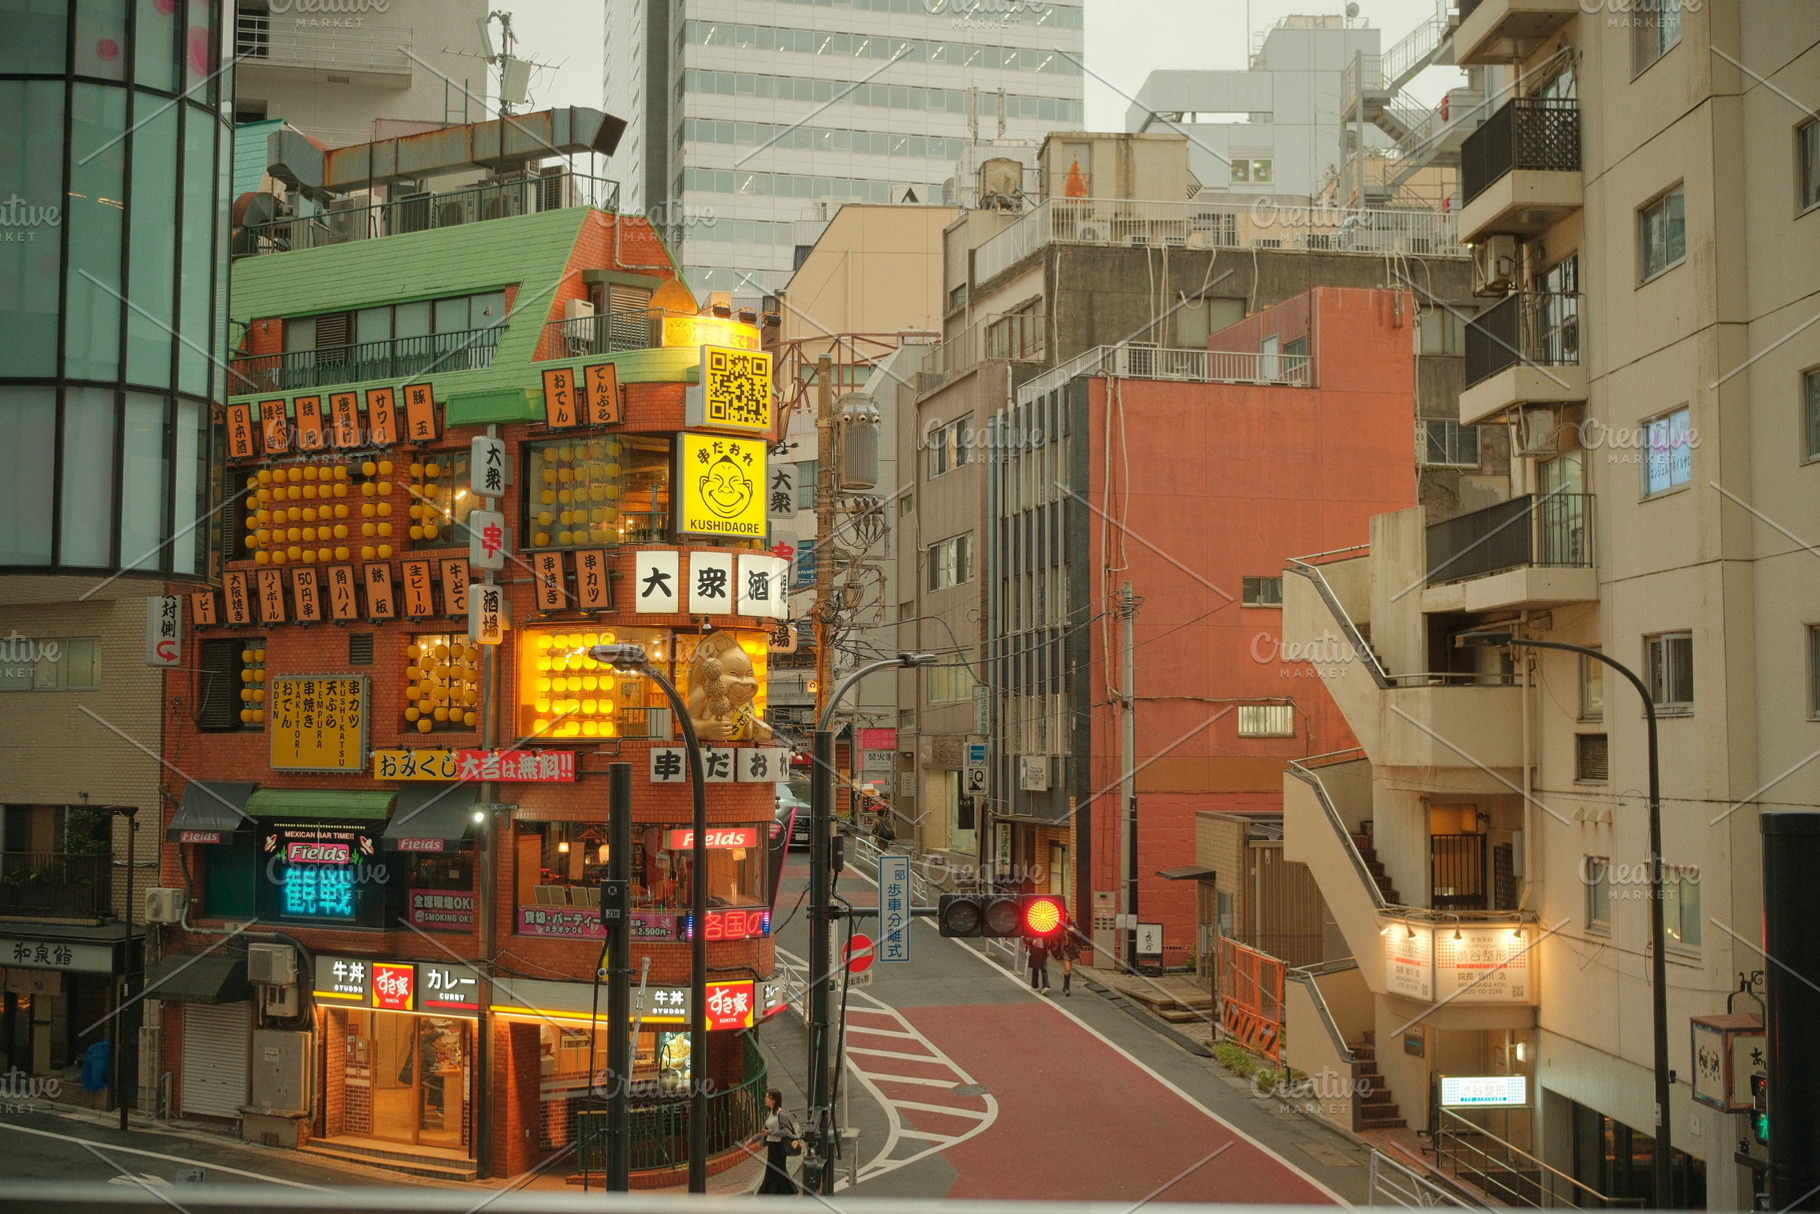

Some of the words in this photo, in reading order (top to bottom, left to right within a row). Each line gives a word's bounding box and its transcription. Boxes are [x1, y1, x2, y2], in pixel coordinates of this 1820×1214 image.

[338, 397, 354, 443] 唐揚げ
[376, 393, 388, 441] サワー
[413, 389, 428, 436] 豚玉
[554, 374, 568, 423] おでん
[234, 408, 248, 454] 日本酒
[697, 442, 753, 466] 串だおれ
[485, 443, 502, 491] 大衆
[770, 469, 792, 514] 大衆
[482, 522, 502, 559] 串
[690, 519, 760, 534] KUSHIDAORE
[230, 574, 244, 622] 大阪焼き
[264, 572, 279, 620] ハイボール
[298, 572, 314, 618] 50円串
[336, 569, 349, 616] 角ハイ
[372, 567, 388, 614] 鉄板
[410, 565, 426, 614] 生ビール
[450, 563, 465, 610] 牛どて
[543, 556, 558, 604] 串焼き
[584, 554, 600, 603] 串カツ
[482, 590, 499, 638] 酒場
[282, 682, 293, 728] おでん
[304, 680, 314, 728] 串焼き
[338, 681, 346, 766] KUSHIKATSU
[348, 680, 360, 728] 串カツ
[380, 754, 457, 778] おみくじ
[654, 750, 788, 781] 串だおれ
[182, 831, 218, 840] Fields
[284, 830, 316, 838] MEXICAN
[333, 832, 354, 840] TIME!!
[290, 845, 347, 861] Fields
[400, 839, 441, 850] Fields
[682, 832, 745, 846] Felds
[894, 863, 906, 880] 一部
[424, 912, 457, 922] SMOKING
[888, 883, 902, 958] 歩車分離式
[333, 961, 365, 983] 牛丼
[376, 968, 408, 998] すき家
[427, 969, 476, 990] カレー
[440, 992, 465, 1002] CURRY
[654, 990, 684, 1006] 牛丼
[708, 987, 748, 1016] すき家
